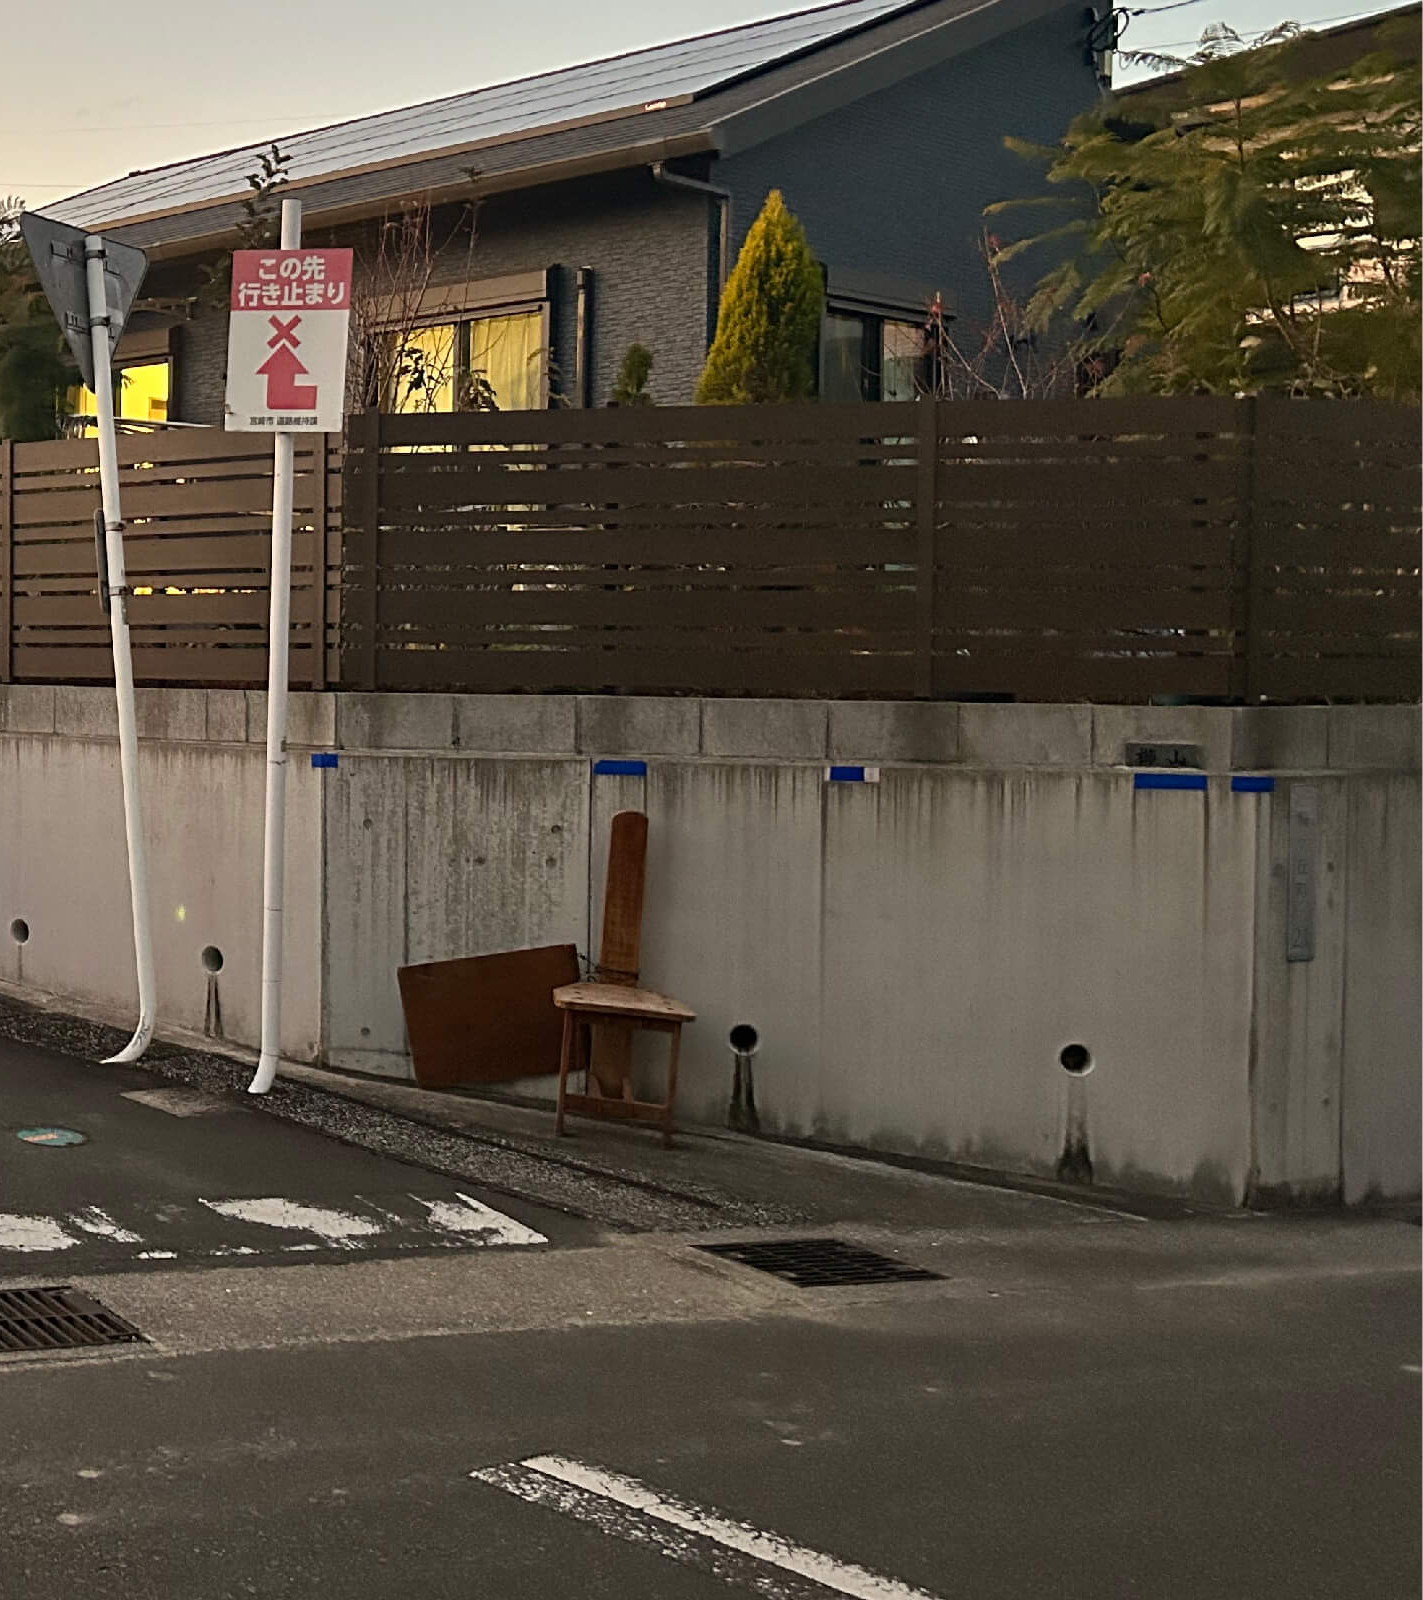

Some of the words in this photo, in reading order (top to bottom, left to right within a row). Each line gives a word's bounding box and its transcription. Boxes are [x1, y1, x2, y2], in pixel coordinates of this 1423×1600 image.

[259, 255, 326, 280] この先
[238, 282, 345, 307] 行き止まり
